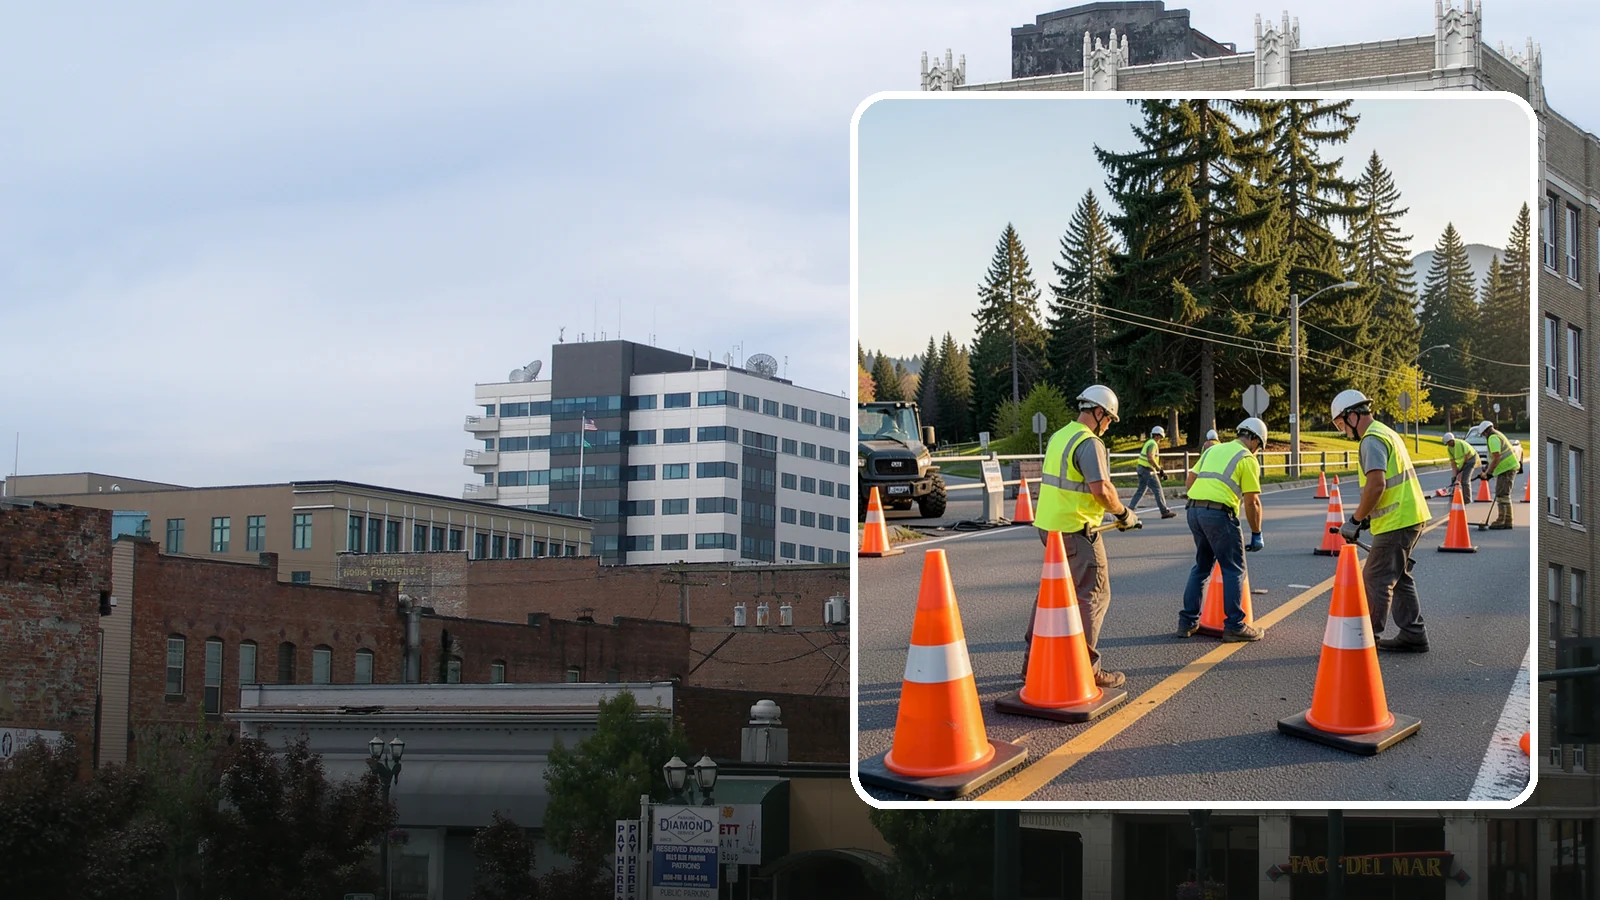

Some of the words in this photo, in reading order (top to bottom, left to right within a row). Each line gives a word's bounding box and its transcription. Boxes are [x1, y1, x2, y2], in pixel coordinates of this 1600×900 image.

[371, 566, 426, 576] Furnishers
[660, 818, 713, 832] DIAMOND
[1022, 815, 1069, 828] BUILDING
[617, 824, 625, 852] PAY
[628, 824, 637, 852] PAY
[656, 845, 688, 853] RESERVED
[671, 862, 701, 870] PATRONS
[1291, 855, 1329, 875] TAC
[1346, 856, 1385, 876] DEL
[1392, 857, 1442, 877] MAR
[616, 856, 625, 894] HERE
[627, 856, 636, 894] HERE
[660, 888, 682, 898] PUBLIC
[683, 889, 710, 899] PARKING
